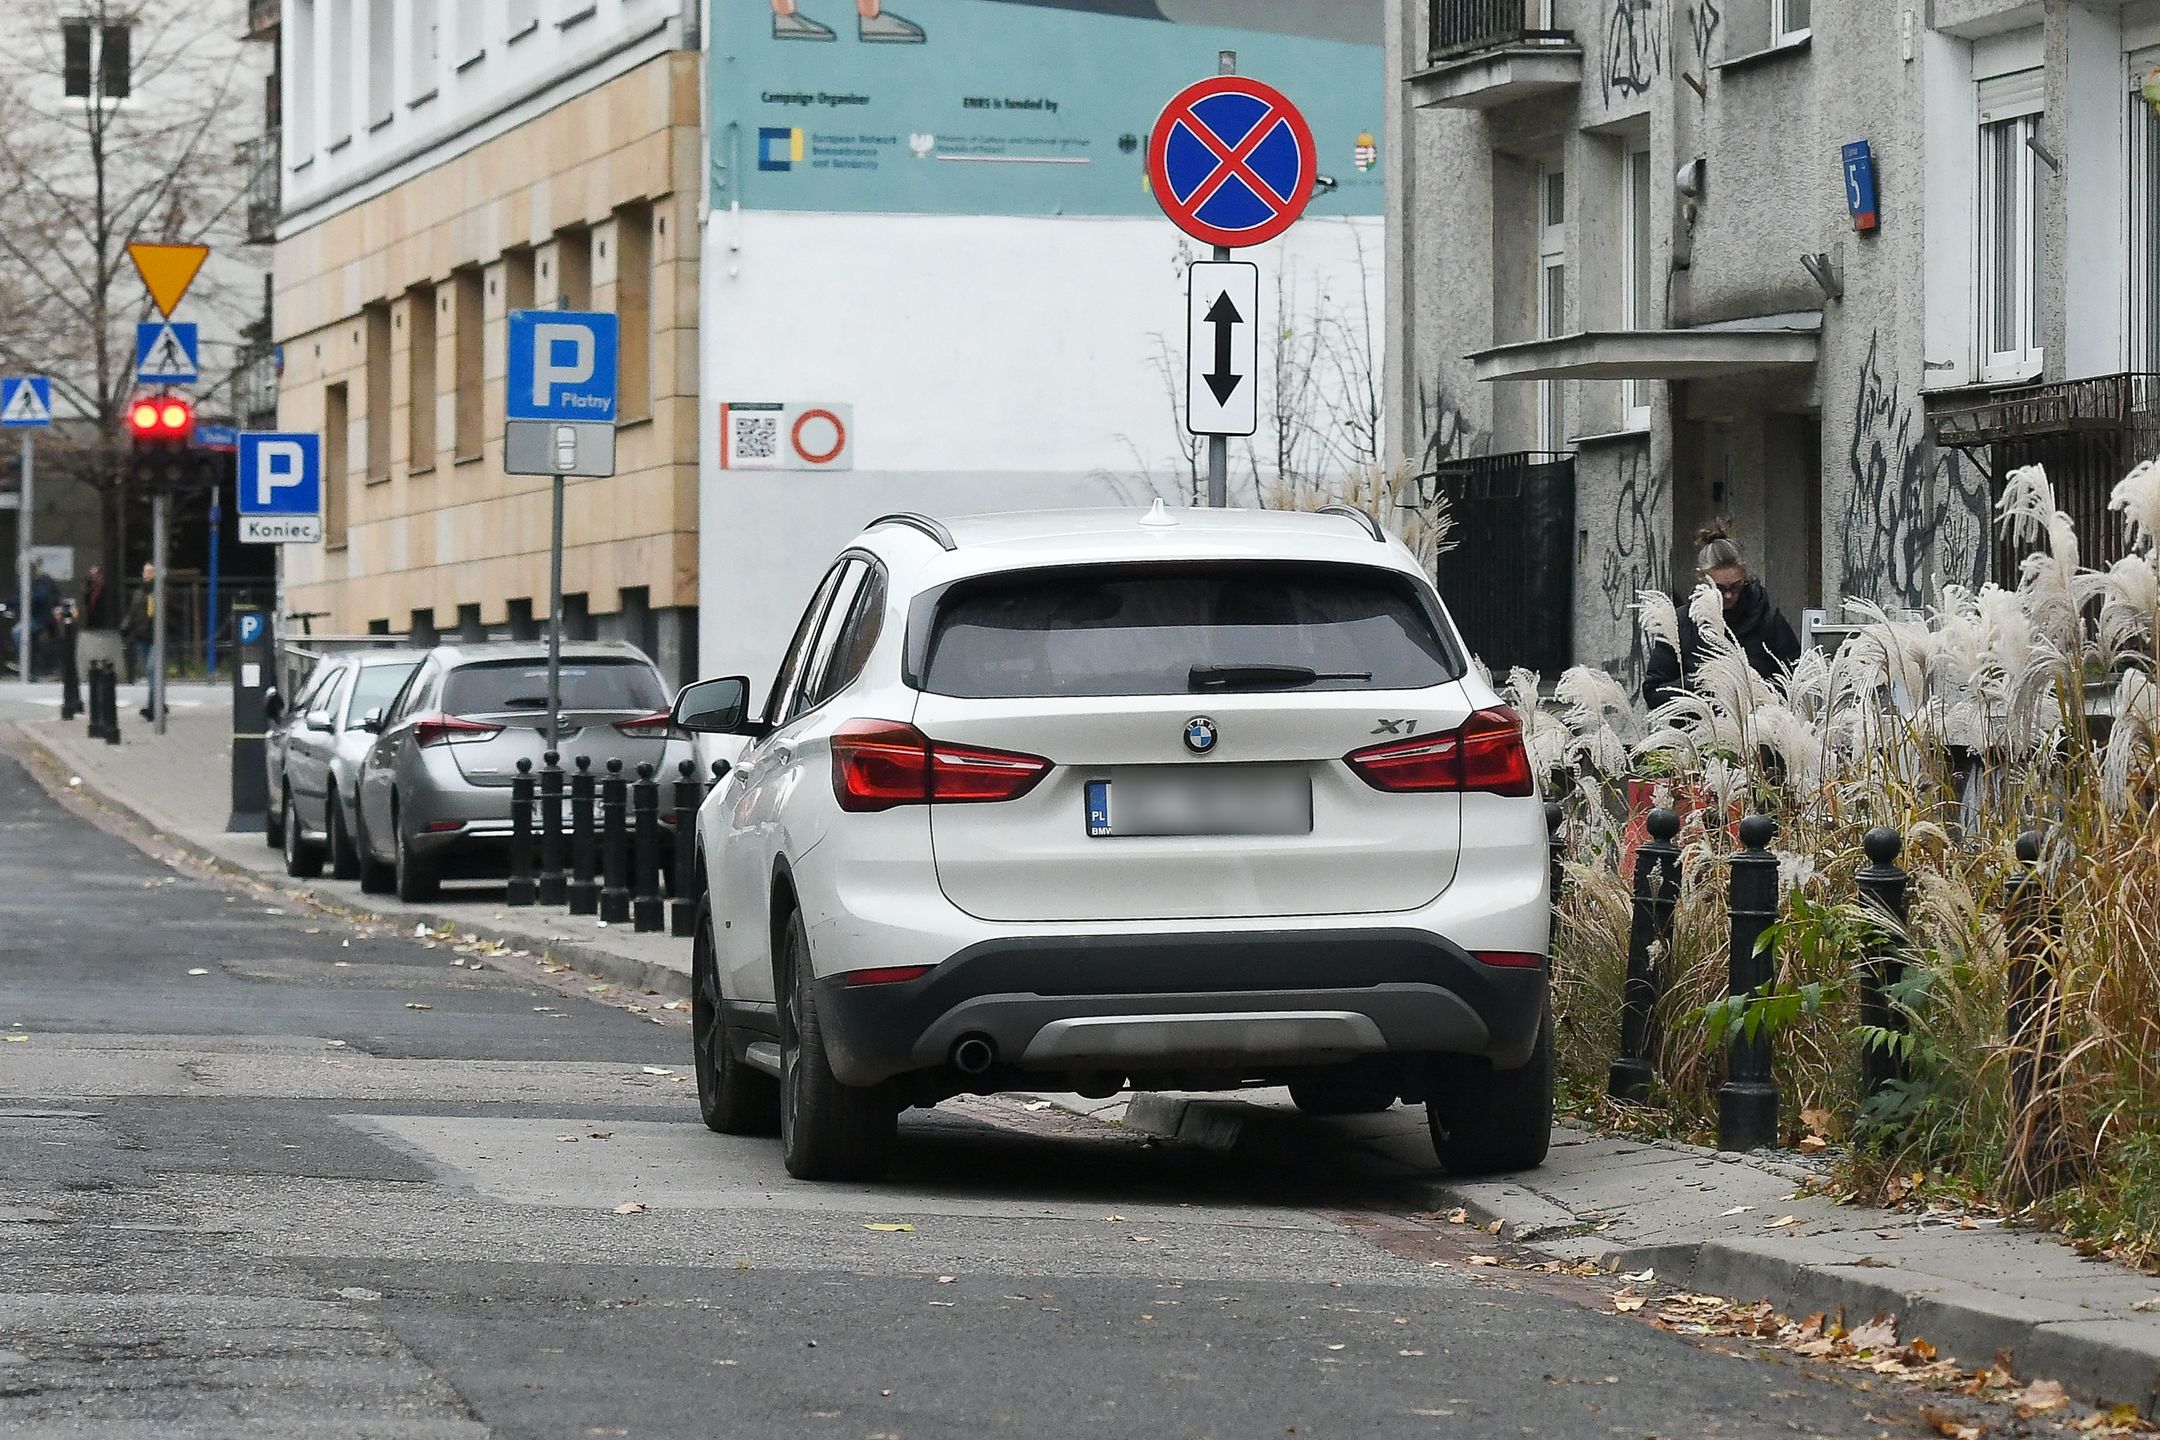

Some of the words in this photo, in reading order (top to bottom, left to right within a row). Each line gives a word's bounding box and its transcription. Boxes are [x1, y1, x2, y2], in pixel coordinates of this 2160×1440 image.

[1848, 164, 1861, 209] 5
[533, 323, 596, 407] P
[257, 441, 304, 505] P
[249, 522, 311, 537] Koniec
[241, 615, 258, 639] P
[1370, 718, 1418, 734] X1
[1091, 811, 1106, 821] PL
